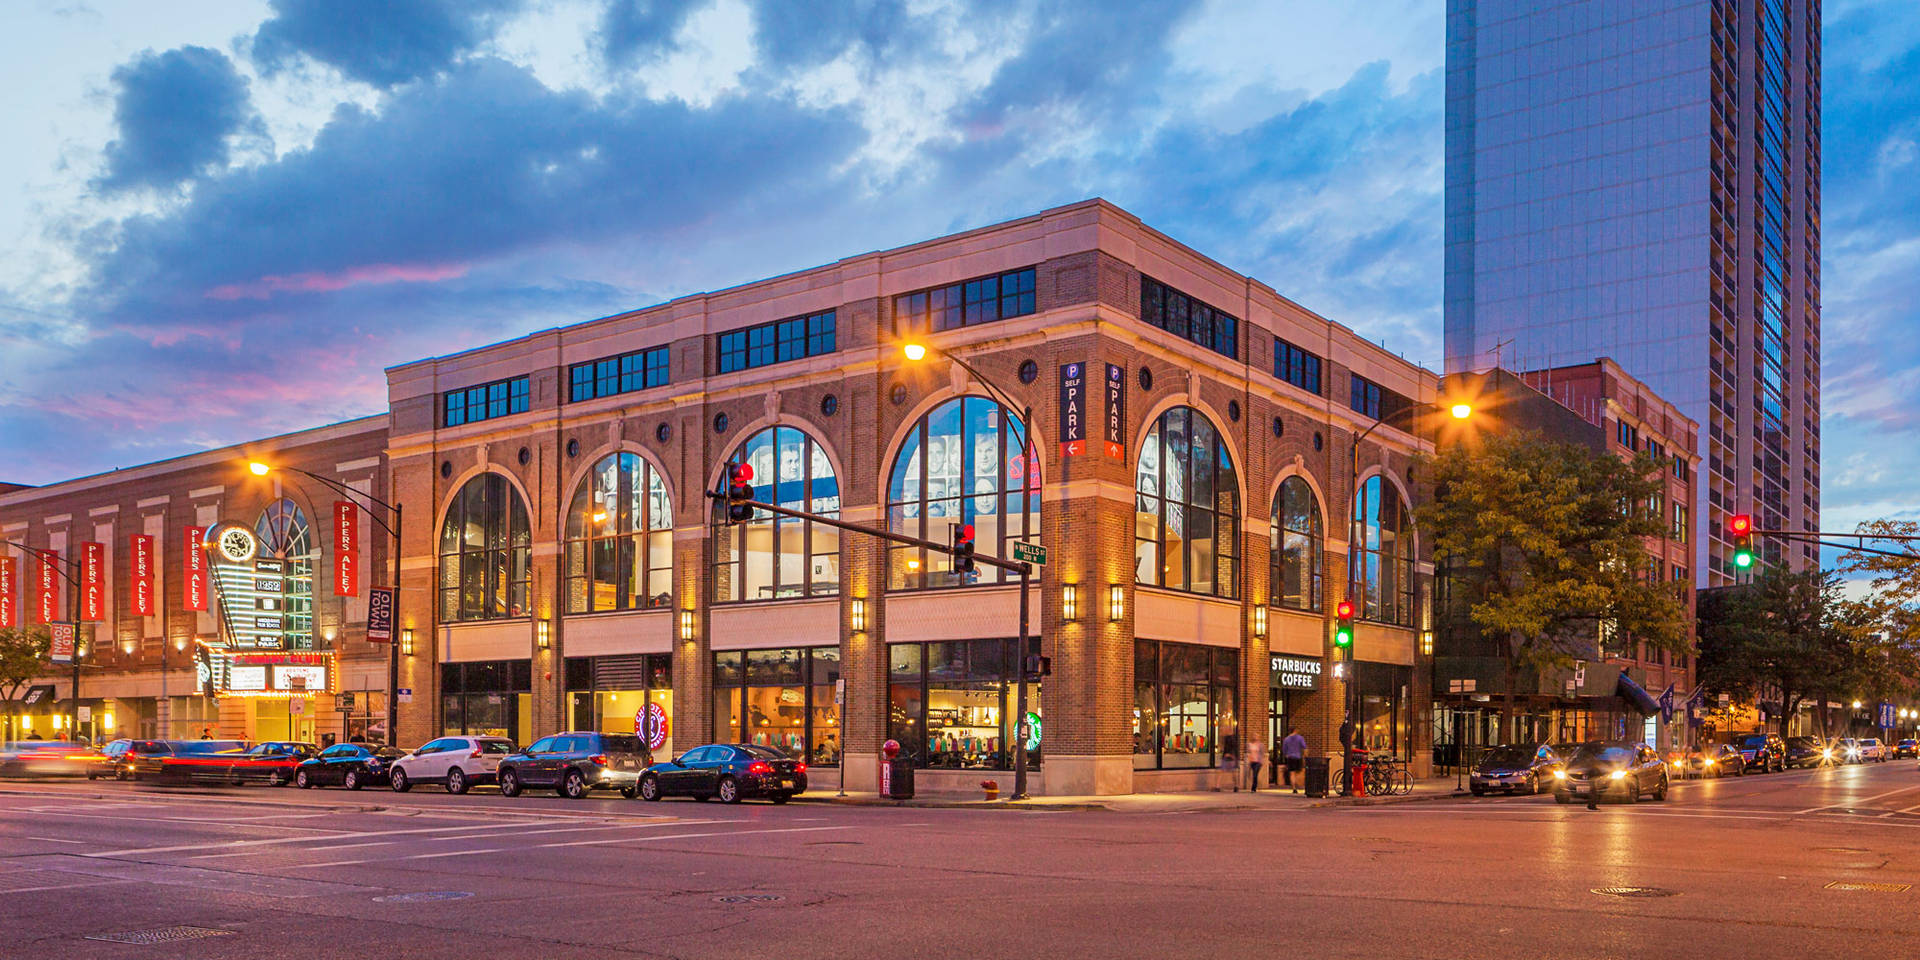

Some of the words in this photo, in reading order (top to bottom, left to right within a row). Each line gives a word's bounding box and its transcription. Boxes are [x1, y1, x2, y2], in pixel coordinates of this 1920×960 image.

[1064, 379, 1081, 388] SELF
[1069, 365, 1077, 377] P
[1109, 380, 1121, 390] SELF
[1068, 388, 1078, 440] PARK
[1111, 389, 1119, 442] PARK
[341, 506, 350, 550] PIPERS
[89, 545, 97, 583] PIPERS
[138, 537, 146, 577] PIPERS
[191, 529, 200, 570] PIPERS
[1019, 544, 1040, 556] WELLS
[341, 555, 351, 593] ALLEY
[43, 591, 52, 622] ALLEY
[89, 586, 97, 618] ALLEY
[138, 580, 147, 613] ALLEY
[191, 574, 201, 608] ALLEY
[381, 593, 390, 618] OLD
[1, 596, 9, 627] ALLEY
[371, 591, 381, 629] TOWN
[53, 625, 63, 655] TOWN
[63, 626, 72, 645] OLD
[1271, 657, 1322, 675] STARBUCKS
[1281, 672, 1313, 687] COFFEE
